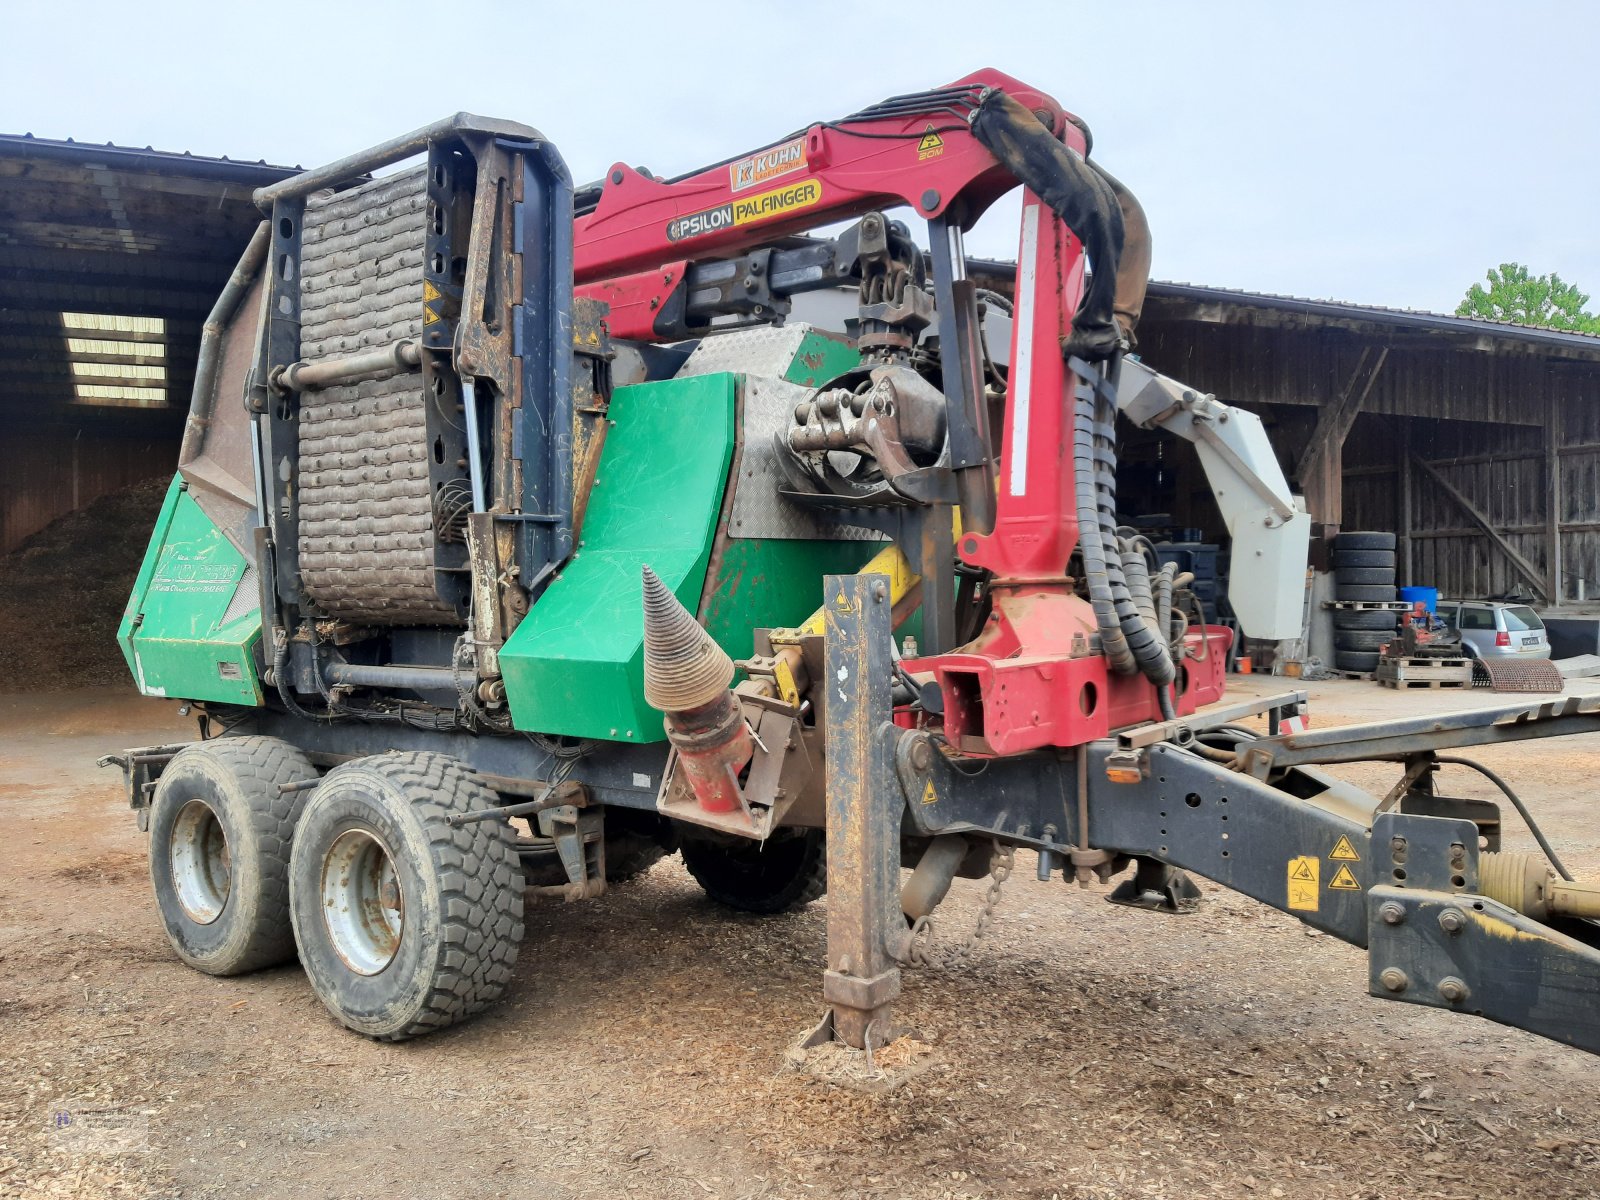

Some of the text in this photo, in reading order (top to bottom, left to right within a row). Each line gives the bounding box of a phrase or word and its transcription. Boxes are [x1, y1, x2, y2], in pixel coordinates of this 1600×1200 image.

[757, 144, 802, 172] KUHN
[919, 148, 944, 160] 20M
[736, 184, 816, 220] PALFINGER
